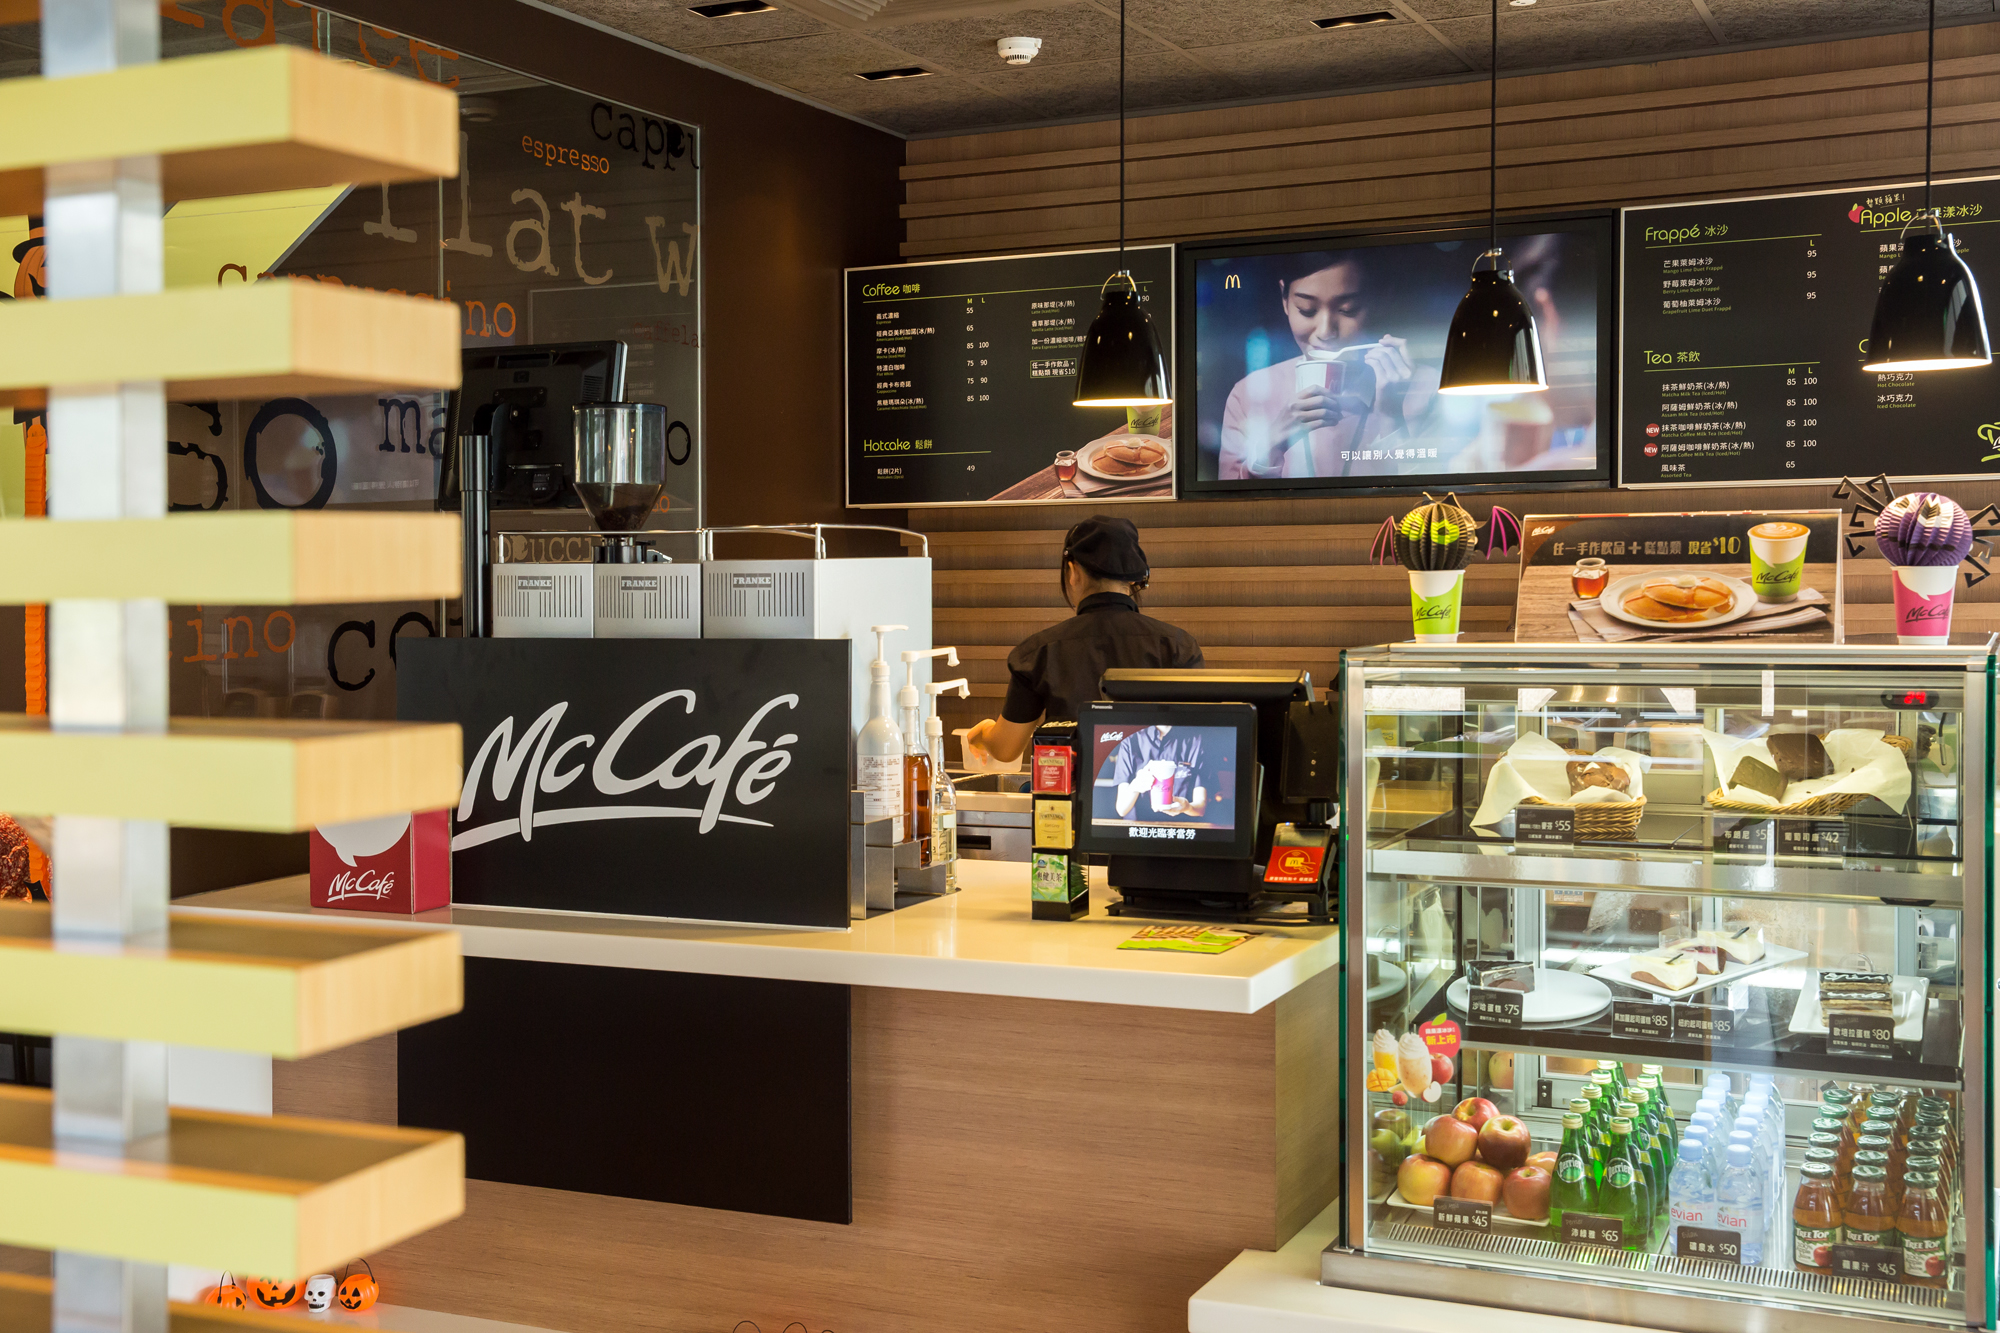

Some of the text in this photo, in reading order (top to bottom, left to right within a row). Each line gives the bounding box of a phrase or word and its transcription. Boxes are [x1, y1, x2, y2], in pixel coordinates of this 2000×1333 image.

[522, 135, 610, 175] espresso
[1860, 206, 1912, 228] Apple
[1645, 223, 1729, 243] Frappé 冰沙
[1809, 239, 1815, 247] L
[1663, 250, 1818, 268] 芒果萊姆冰沙 95
[1806, 271, 1817, 279] 95
[862, 283, 921, 297] Coffee 咖啡
[1663, 291, 1817, 309] 葡萄柚萊姆冰沙 95
[966, 324, 974, 332] 65
[1643, 350, 1701, 365] Tea 茶飲
[1788, 366, 1813, 375] M L
[1877, 372, 1914, 382] 熱巧克力
[966, 377, 975, 385] 75
[980, 376, 988, 384] 90
[1662, 377, 1818, 392] 抹茶鮮奶茶(冰/熱) 85 100
[979, 394, 990, 402] 100
[1786, 398, 1797, 407] 85
[1803, 398, 1818, 406] 100
[1876, 393, 1914, 404] 冰巧克力
[1646, 426, 1660, 434] NEW
[1786, 419, 1797, 428] 85
[1803, 418, 1818, 427] 100
[863, 438, 933, 452] Hotcake 鬆餅
[1644, 446, 1658, 454] NEW
[1785, 440, 1796, 448] 85
[1802, 439, 1817, 448] 100
[1340, 447, 1438, 463] 可以讓別人覺得溫暖
[966, 464, 976, 472] 49
[1660, 460, 1796, 473] 風味茶 65
[1552, 540, 1626, 557] 任一手作飲品
[1643, 540, 1683, 556] 糕點類
[517, 578, 552, 588] FRANKE
[621, 579, 658, 588] FRANKE
[733, 576, 772, 585] FRANKE
[1904, 690, 1926, 704] 24
[456, 688, 799, 842] McCafé
[1554, 819, 1571, 831] $55
[1128, 826, 1197, 841] 歡迎光臨麥當勞
[1724, 830, 1750, 840] 布朗尼
[1821, 831, 1840, 844] $42
[327, 868, 395, 904] McCafé
[1504, 1003, 1520, 1016] $75
[1651, 1014, 1669, 1028] $85
[1714, 1019, 1732, 1033] $85
[1425, 1034, 1457, 1046] 新上市
[1871, 1028, 1891, 1042] $80
[1438, 1212, 1470, 1225] 新鮮蘋果
[1471, 1214, 1488, 1228] $45
[1670, 1207, 1704, 1222] evian
[1717, 1212, 1748, 1229] evian
[1601, 1228, 1620, 1243] $65
[1795, 1226, 1831, 1240] TREE TOP
[1846, 1229, 1881, 1243] TREE TOP
[1718, 1242, 1738, 1257] $50
[1876, 1261, 1897, 1277] $45
